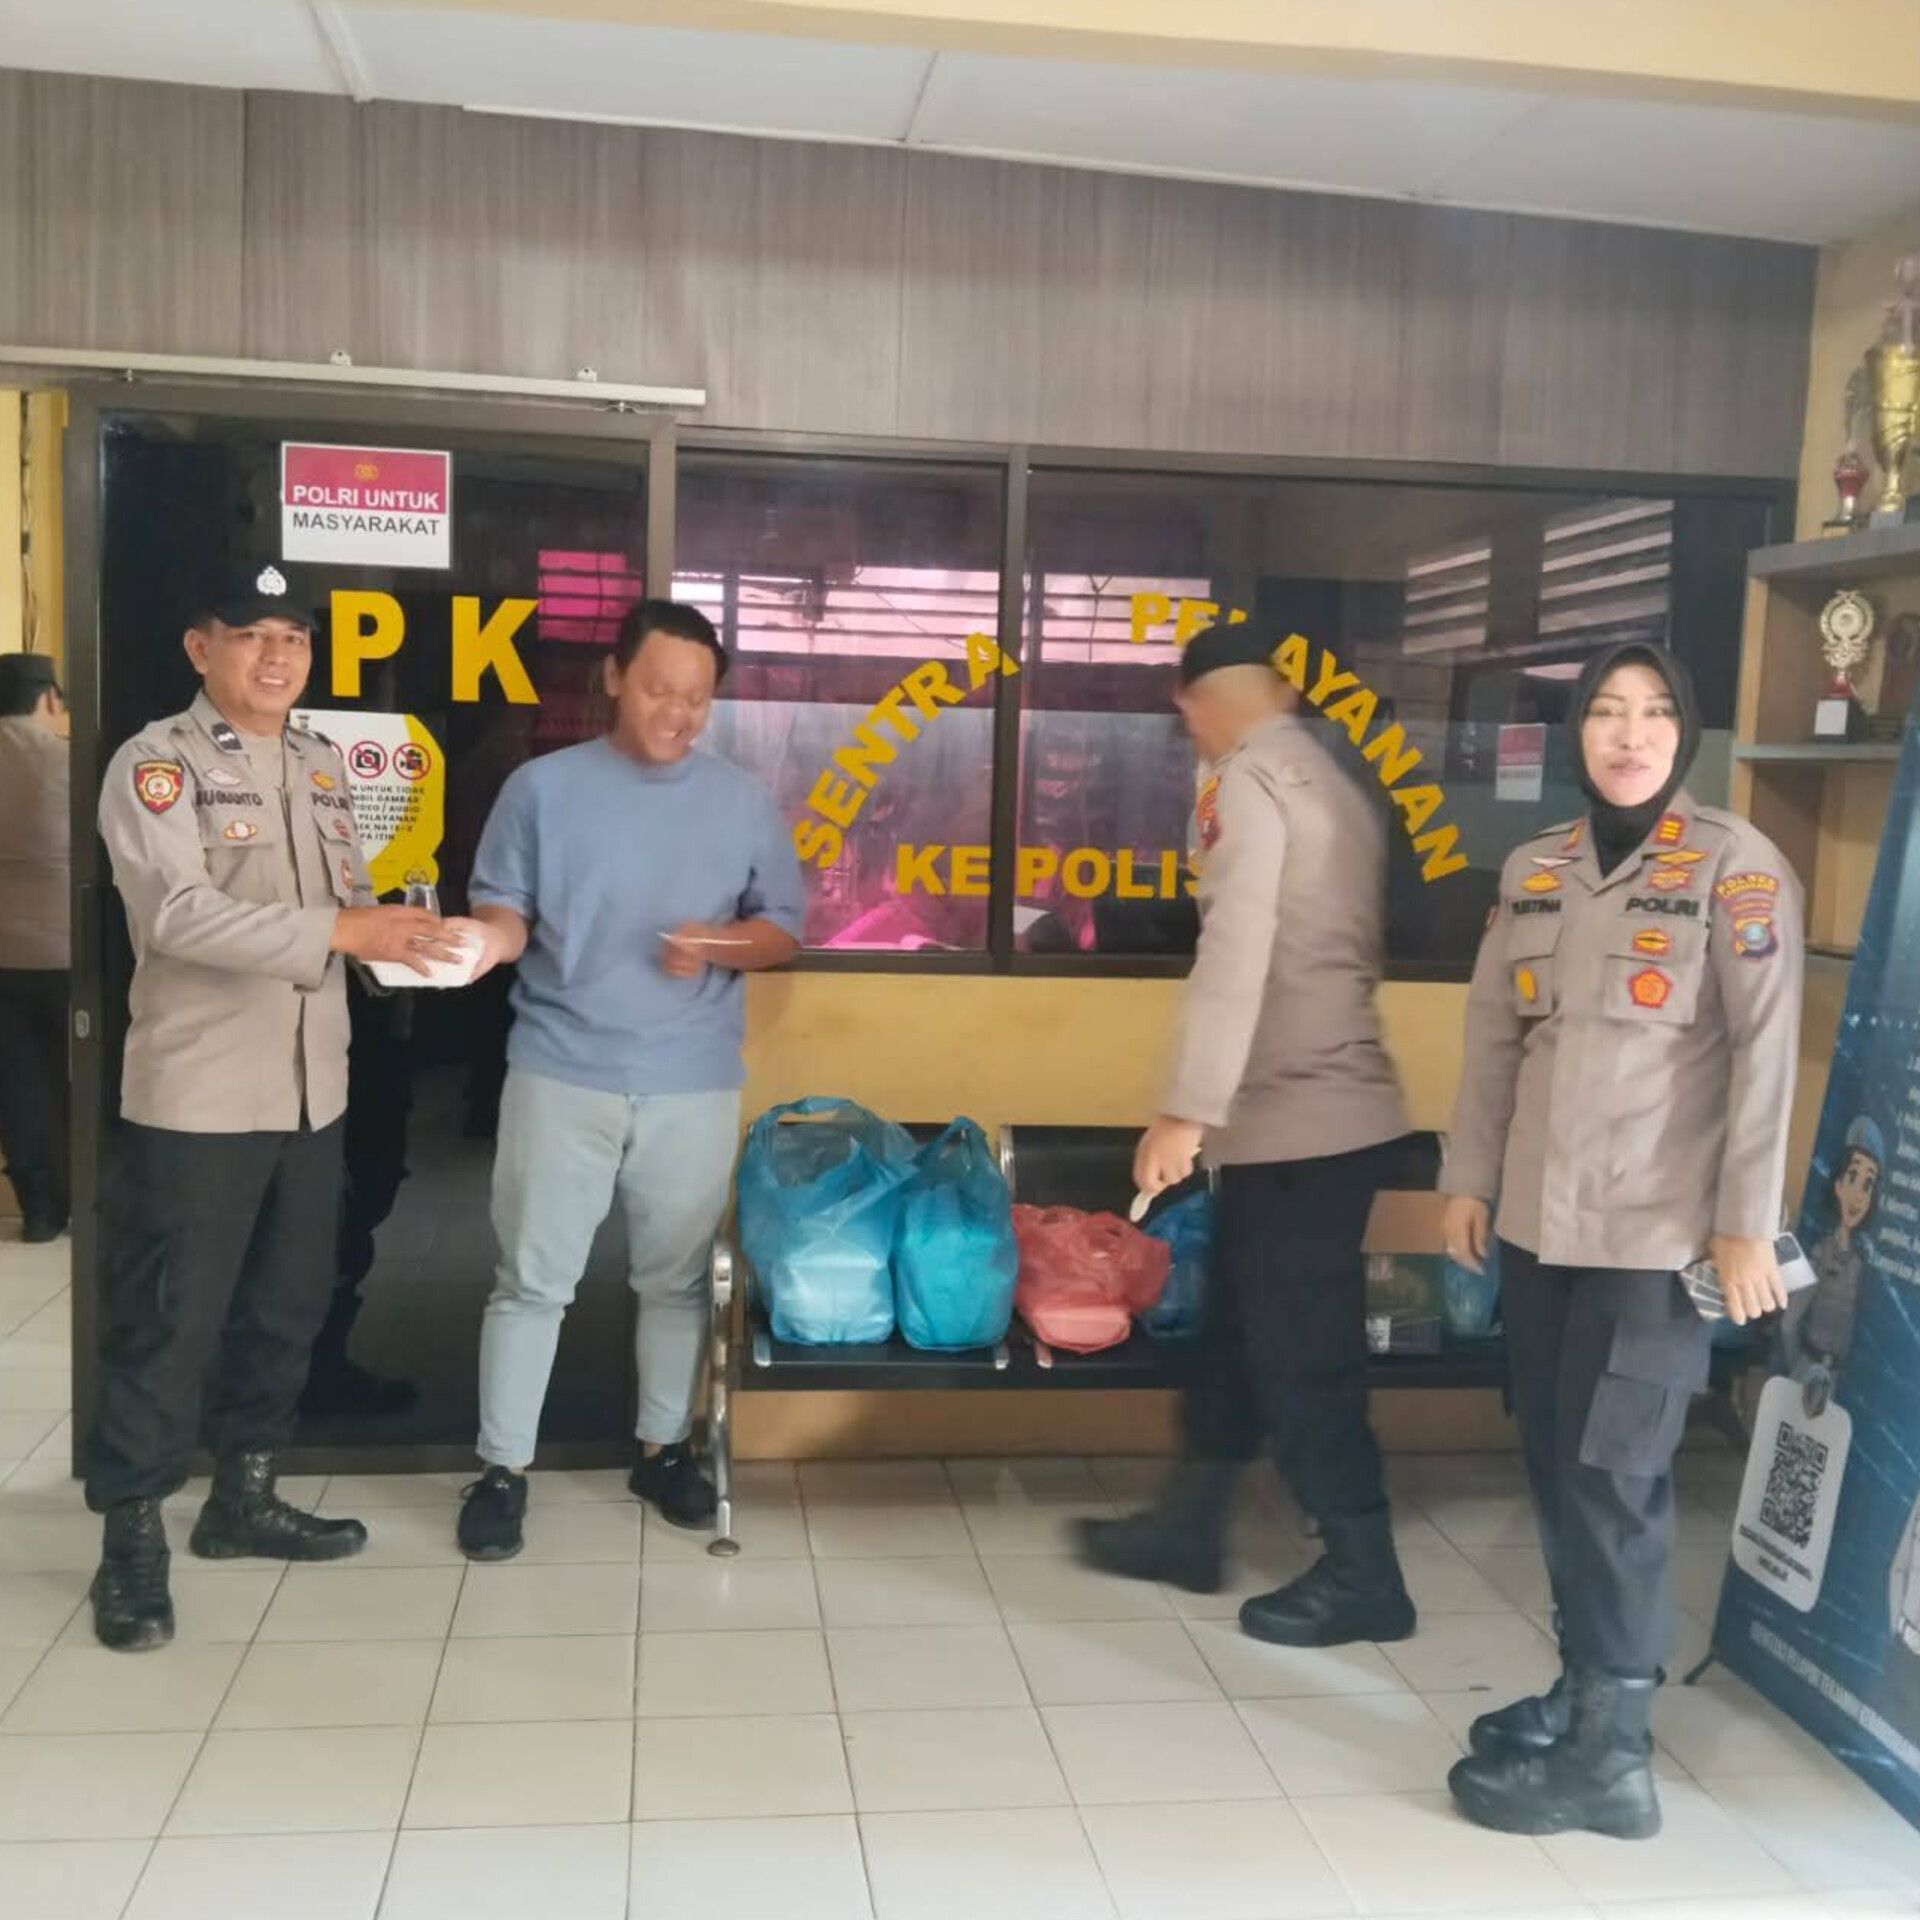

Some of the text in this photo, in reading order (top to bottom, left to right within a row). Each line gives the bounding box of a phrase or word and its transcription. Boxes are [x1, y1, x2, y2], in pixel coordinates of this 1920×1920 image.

[293, 485, 439, 510] POLRI UNTUK
[293, 512, 440, 535] MASYARAKAT
[1130, 590, 1469, 882] PEAYANAN
[792, 631, 1020, 869] SENTRA
[1625, 897, 1699, 916] POLRI
